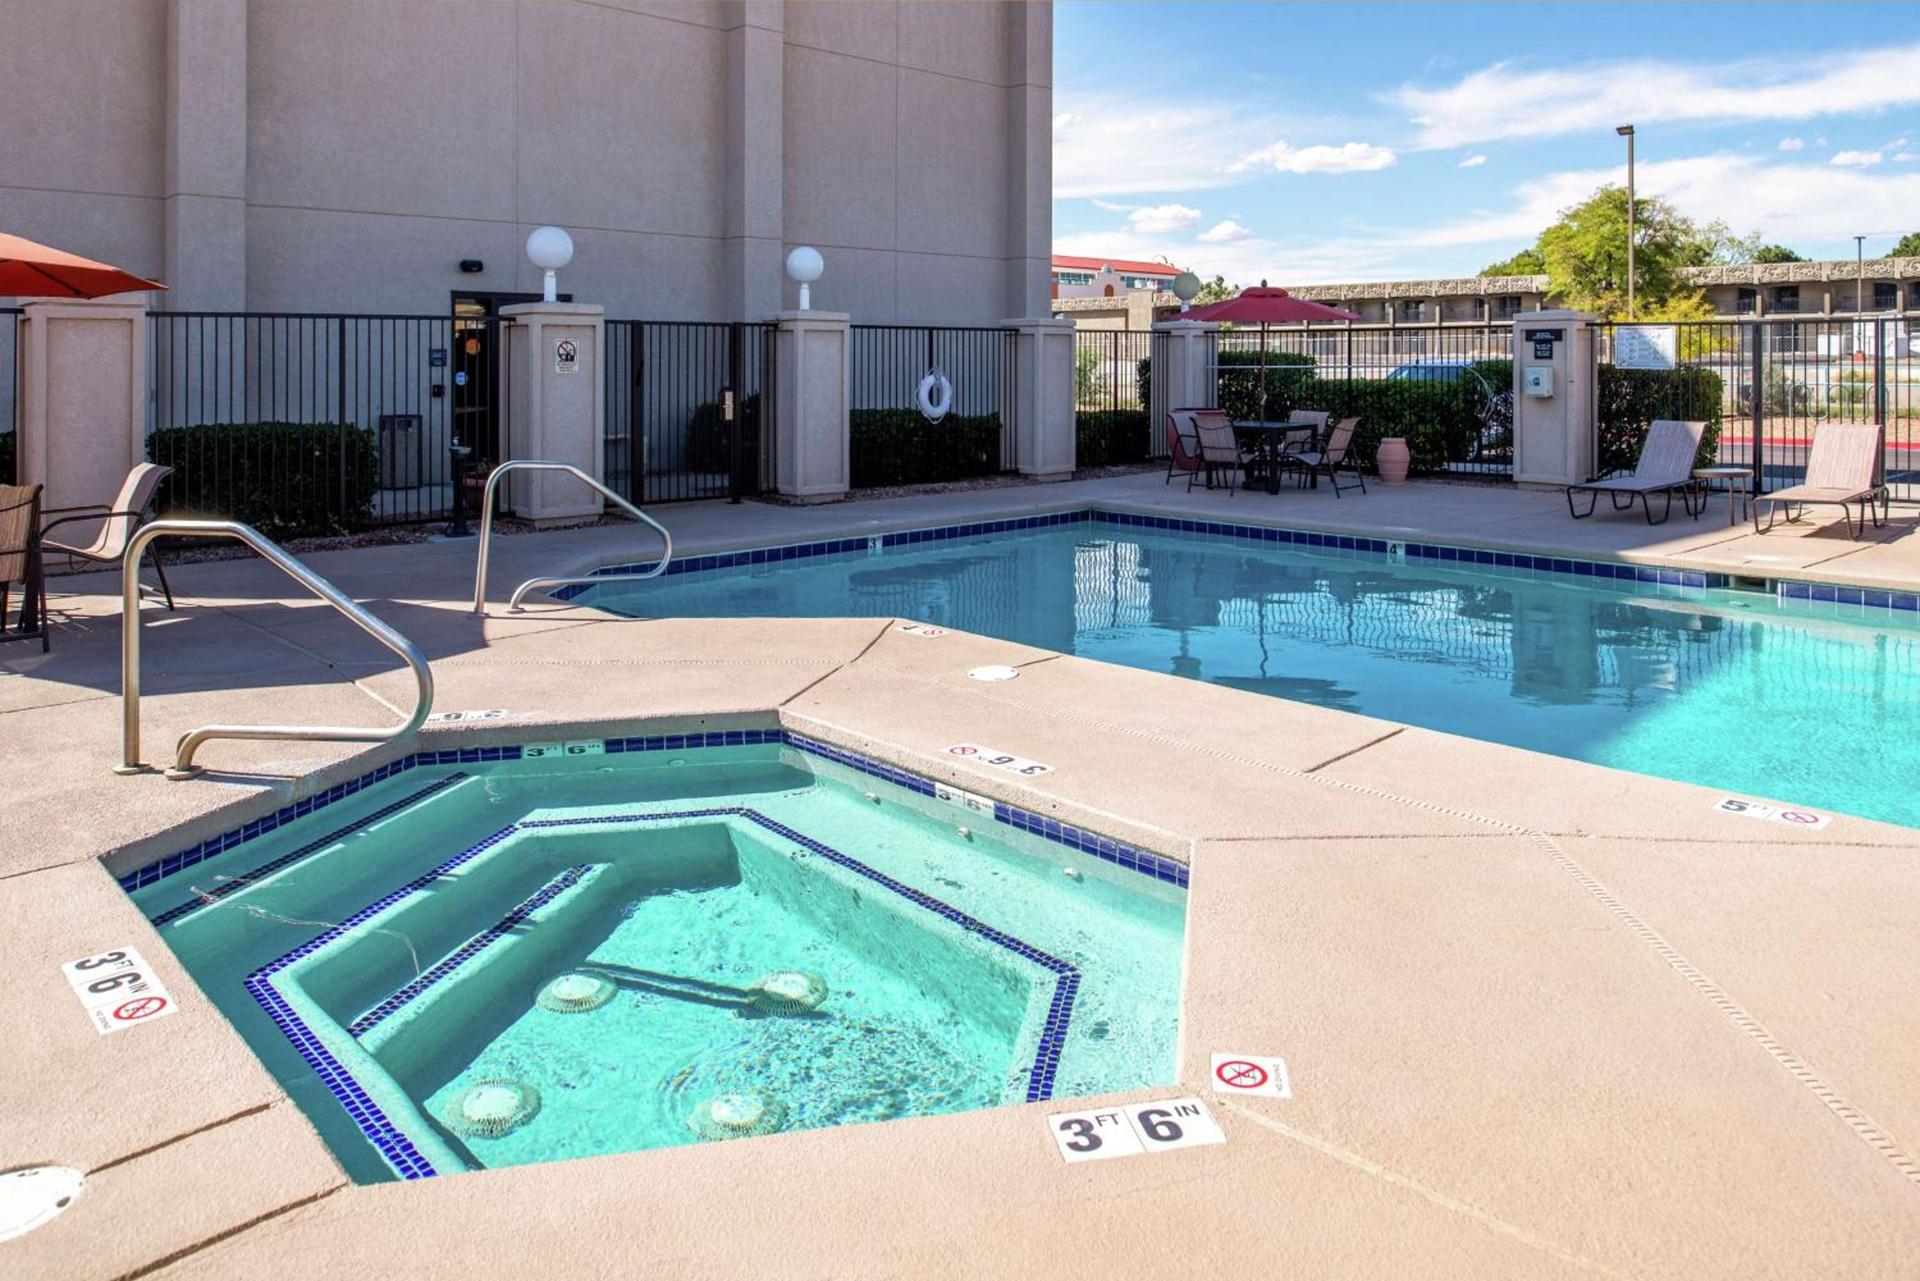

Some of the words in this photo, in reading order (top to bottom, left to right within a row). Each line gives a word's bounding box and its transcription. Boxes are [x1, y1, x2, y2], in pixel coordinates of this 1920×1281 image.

[869, 537, 877, 550] 3
[1389, 543, 1397, 554] 4
[526, 747, 545, 758] 3
[567, 745, 586, 755] 6
[987, 755, 1015, 765] 6
[1019, 765, 1047, 776] 3
[937, 787, 952, 801] 3
[1720, 799, 1750, 812] 5
[74, 951, 127, 971] 3
[87, 971, 142, 994] 6
[1059, 1118, 1103, 1153] 3
[1095, 1112, 1121, 1128] FT
[1137, 1108, 1183, 1142] 6
[1173, 1103, 1201, 1118] IN
